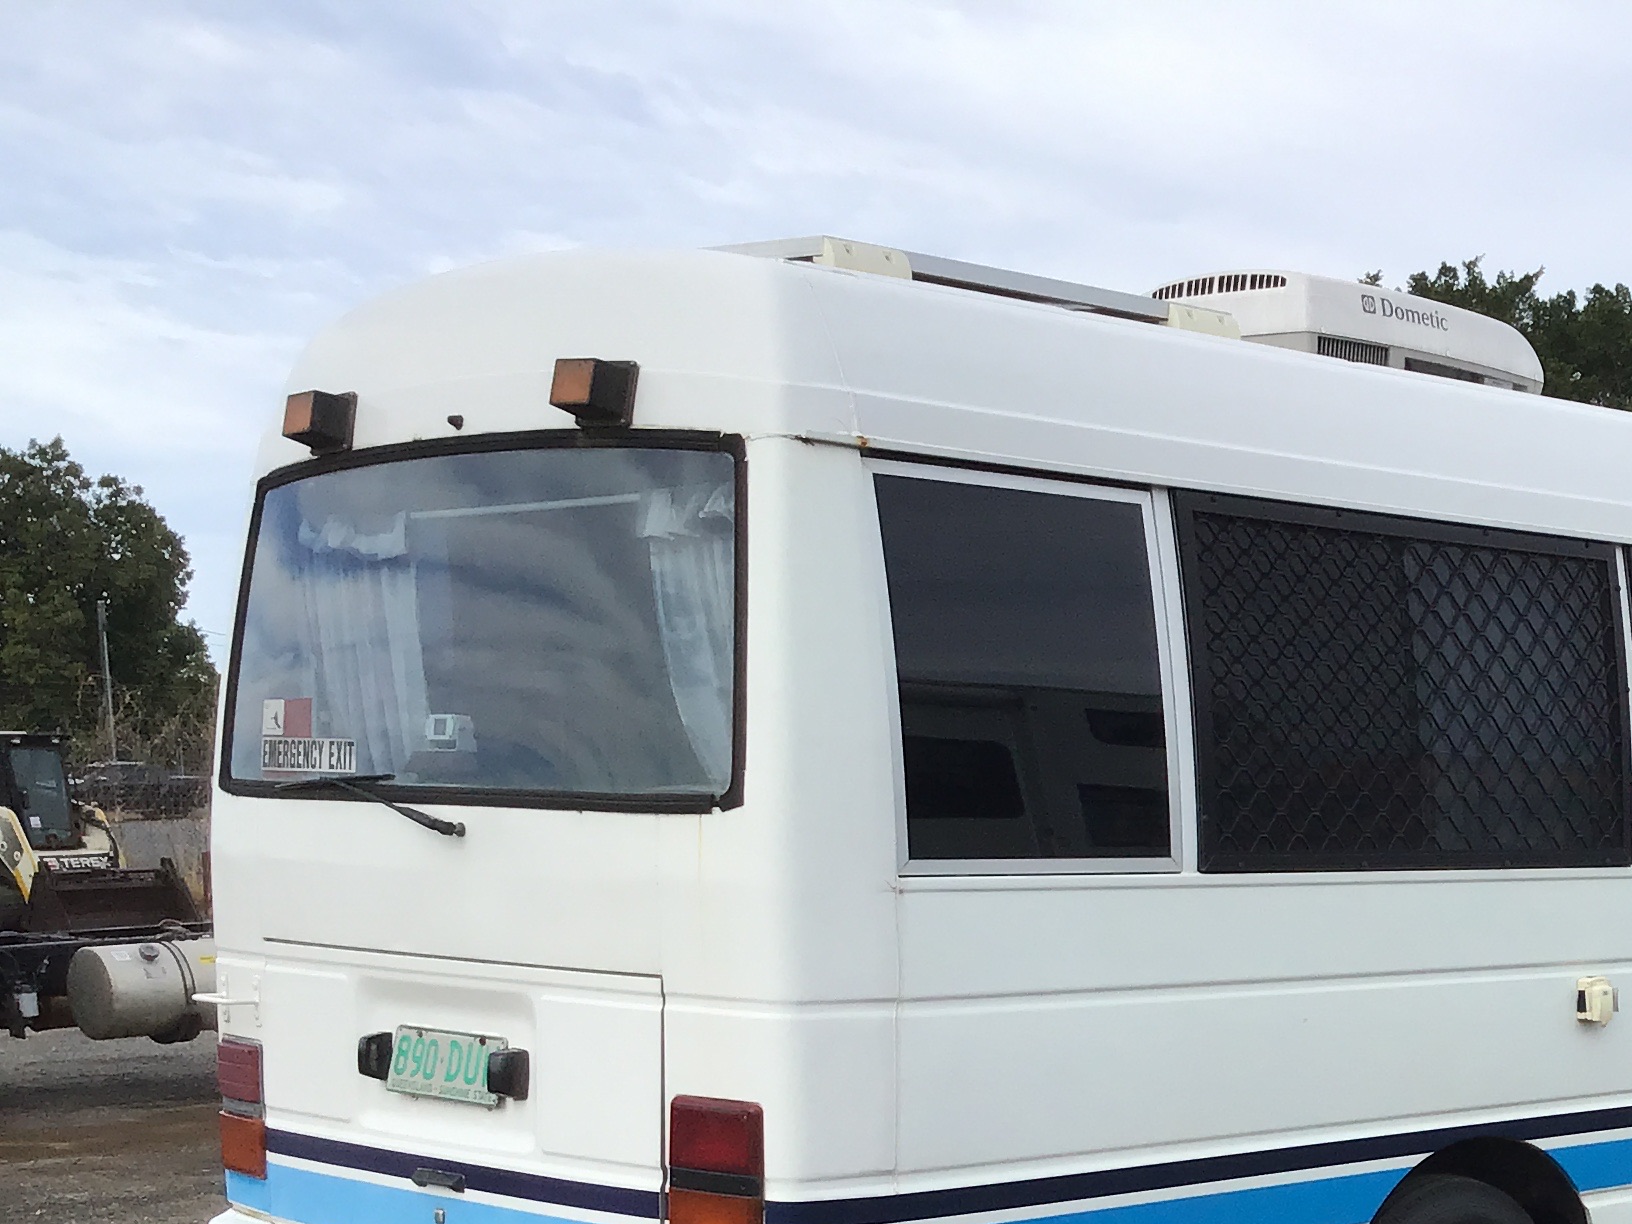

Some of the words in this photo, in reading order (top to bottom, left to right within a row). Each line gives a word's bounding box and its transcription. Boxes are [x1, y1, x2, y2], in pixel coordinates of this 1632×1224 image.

[1380, 297, 1449, 332] Dometic
[262, 739, 325, 769] EMERGENCY
[328, 740, 355, 771] EXIT
[60, 856, 112, 870] TEREX
[394, 1034, 440, 1081] 890
[443, 1039, 490, 1088] DU
